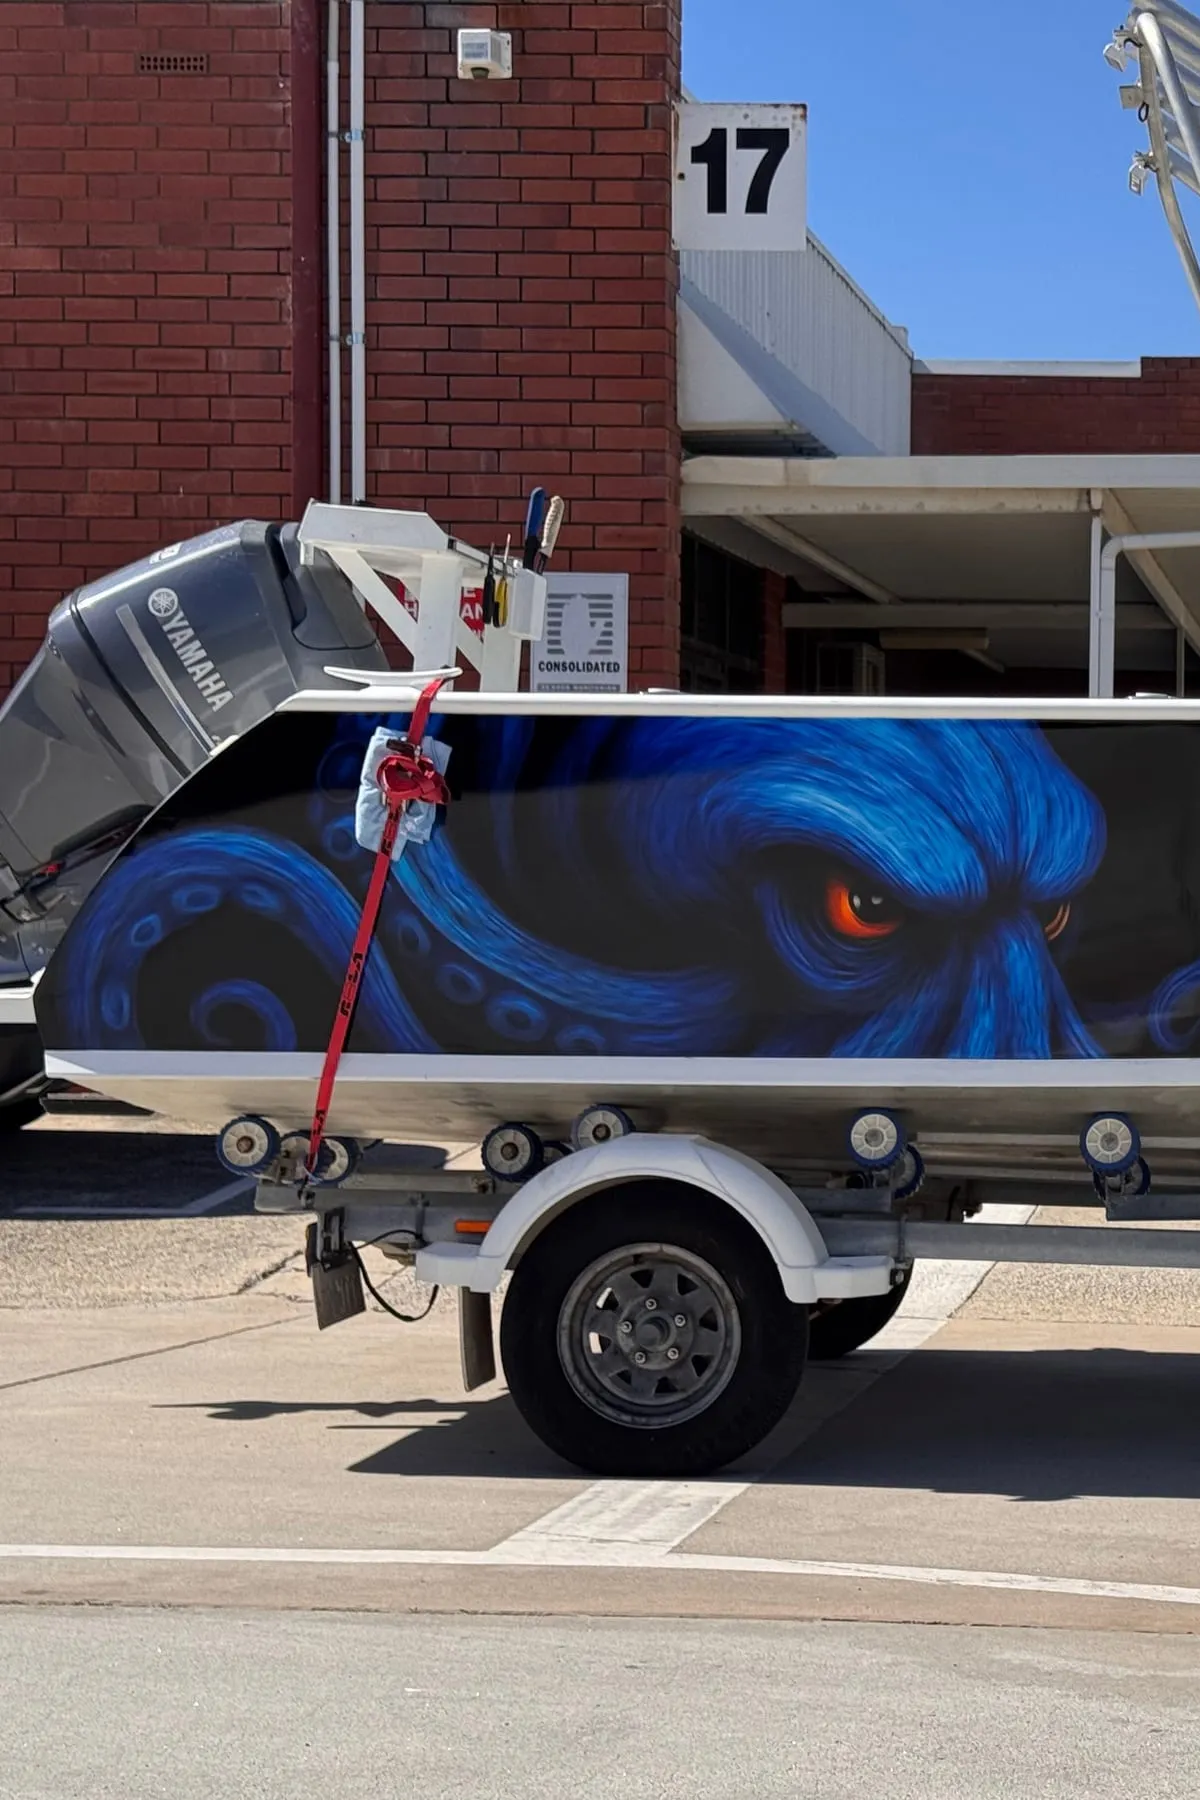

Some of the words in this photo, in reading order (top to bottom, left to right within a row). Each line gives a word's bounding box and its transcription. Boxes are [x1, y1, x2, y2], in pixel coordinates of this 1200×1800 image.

[690, 127, 790, 215] 17
[161, 610, 235, 713] YAMAHA
[538, 661, 620, 673] CONSOLIDATED
